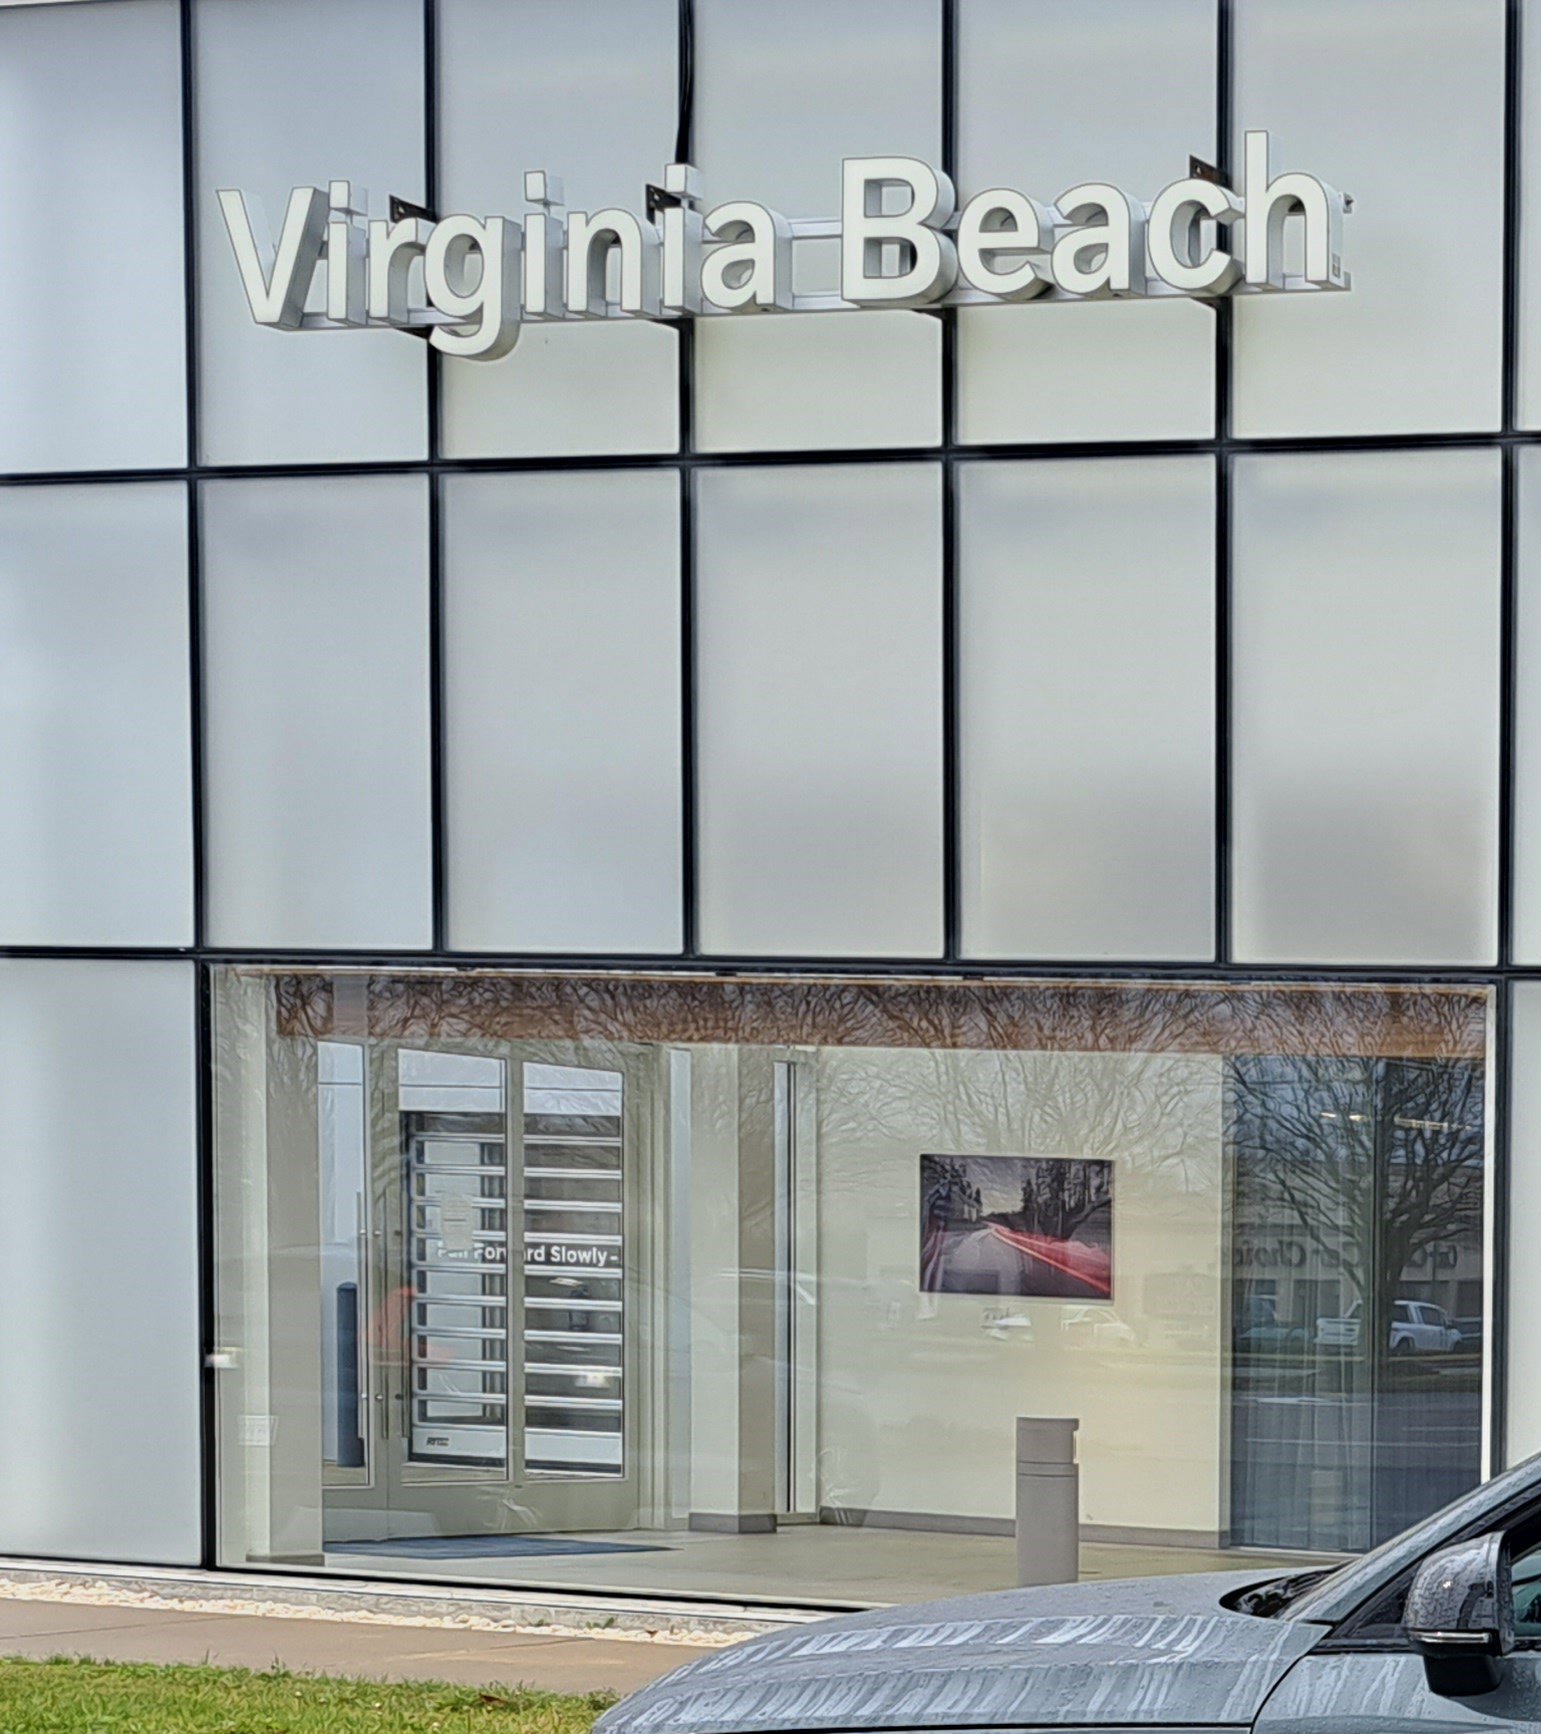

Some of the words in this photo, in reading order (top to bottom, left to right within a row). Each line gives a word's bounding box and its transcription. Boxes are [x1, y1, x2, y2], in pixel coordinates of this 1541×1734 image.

[216, 163, 795, 362] Virginia
[841, 130, 1345, 305] Beach
[474, 1241, 545, 1262] Forrd
[551, 1247, 607, 1267] Slowly
